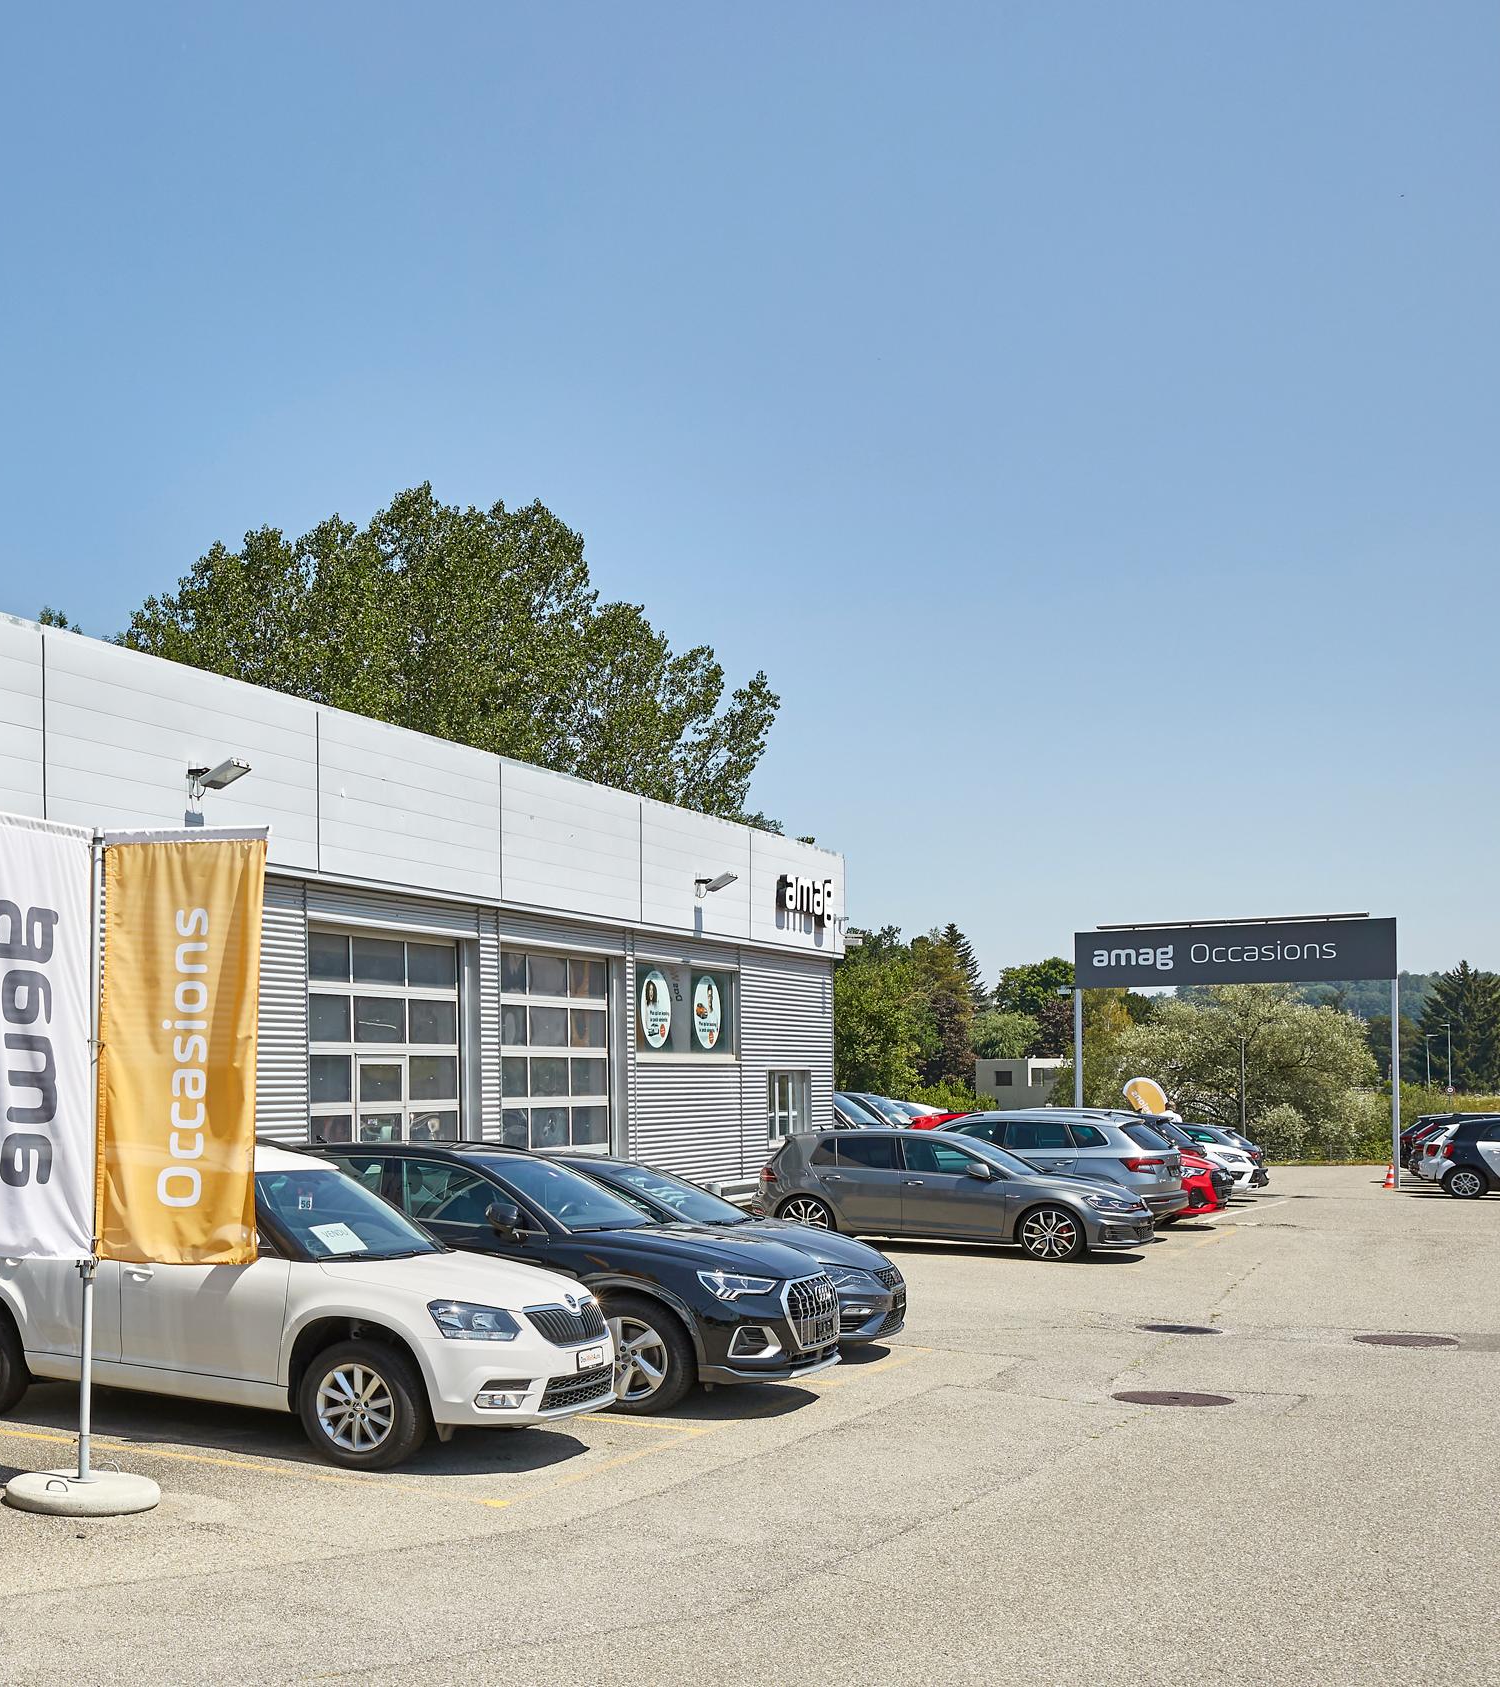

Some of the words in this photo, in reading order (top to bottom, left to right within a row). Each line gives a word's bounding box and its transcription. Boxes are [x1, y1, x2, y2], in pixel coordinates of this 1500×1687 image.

[784, 874, 835, 928] amag
[1092, 944, 1174, 971] amag
[1189, 940, 1338, 964] Occasions
[156, 907, 209, 1208] Occasions
